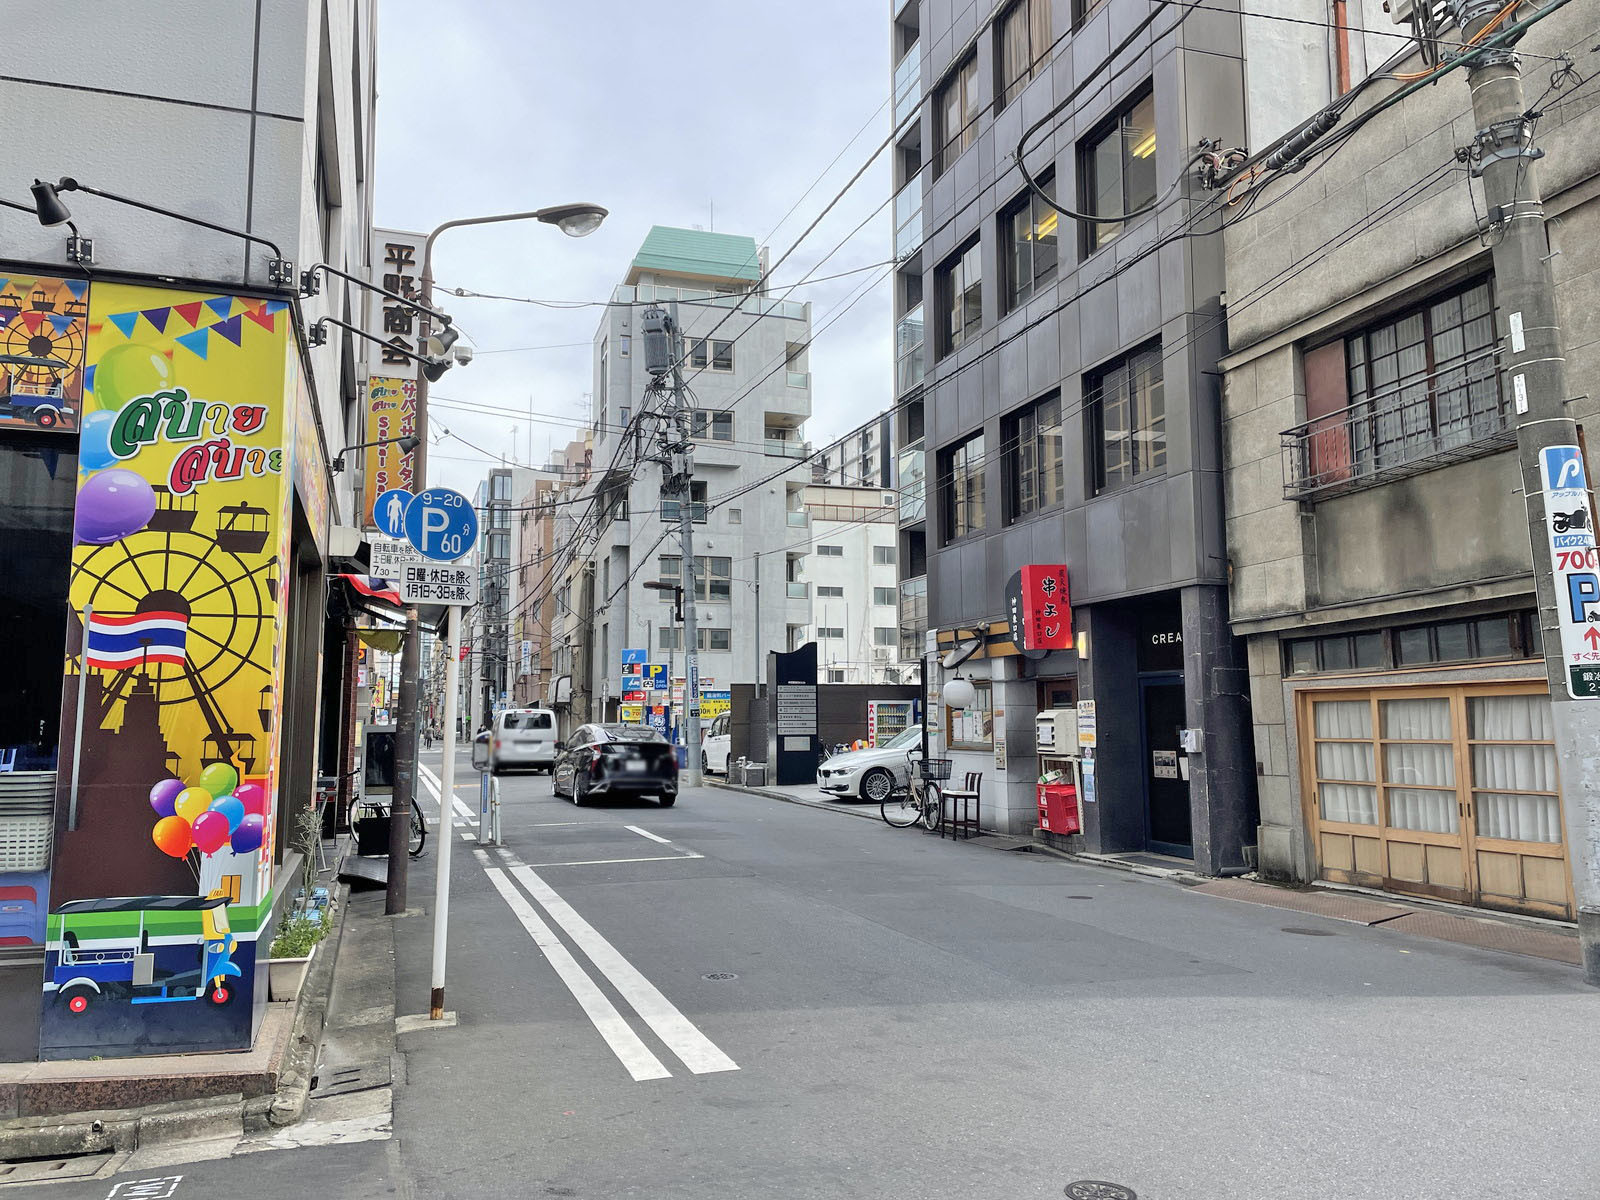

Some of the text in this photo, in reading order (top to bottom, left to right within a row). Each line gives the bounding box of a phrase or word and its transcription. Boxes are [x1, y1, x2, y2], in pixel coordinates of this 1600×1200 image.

[382, 243, 415, 366] 平野商会
[399, 384, 416, 491] サバイサイタイ
[422, 492, 463, 508] 9-20
[421, 506, 450, 552] P
[441, 523, 470, 554] 60 分
[406, 567, 471, 585] 日曜・休日を除く
[1566, 573, 1600, 624] P
[649, 665, 663, 678] P
